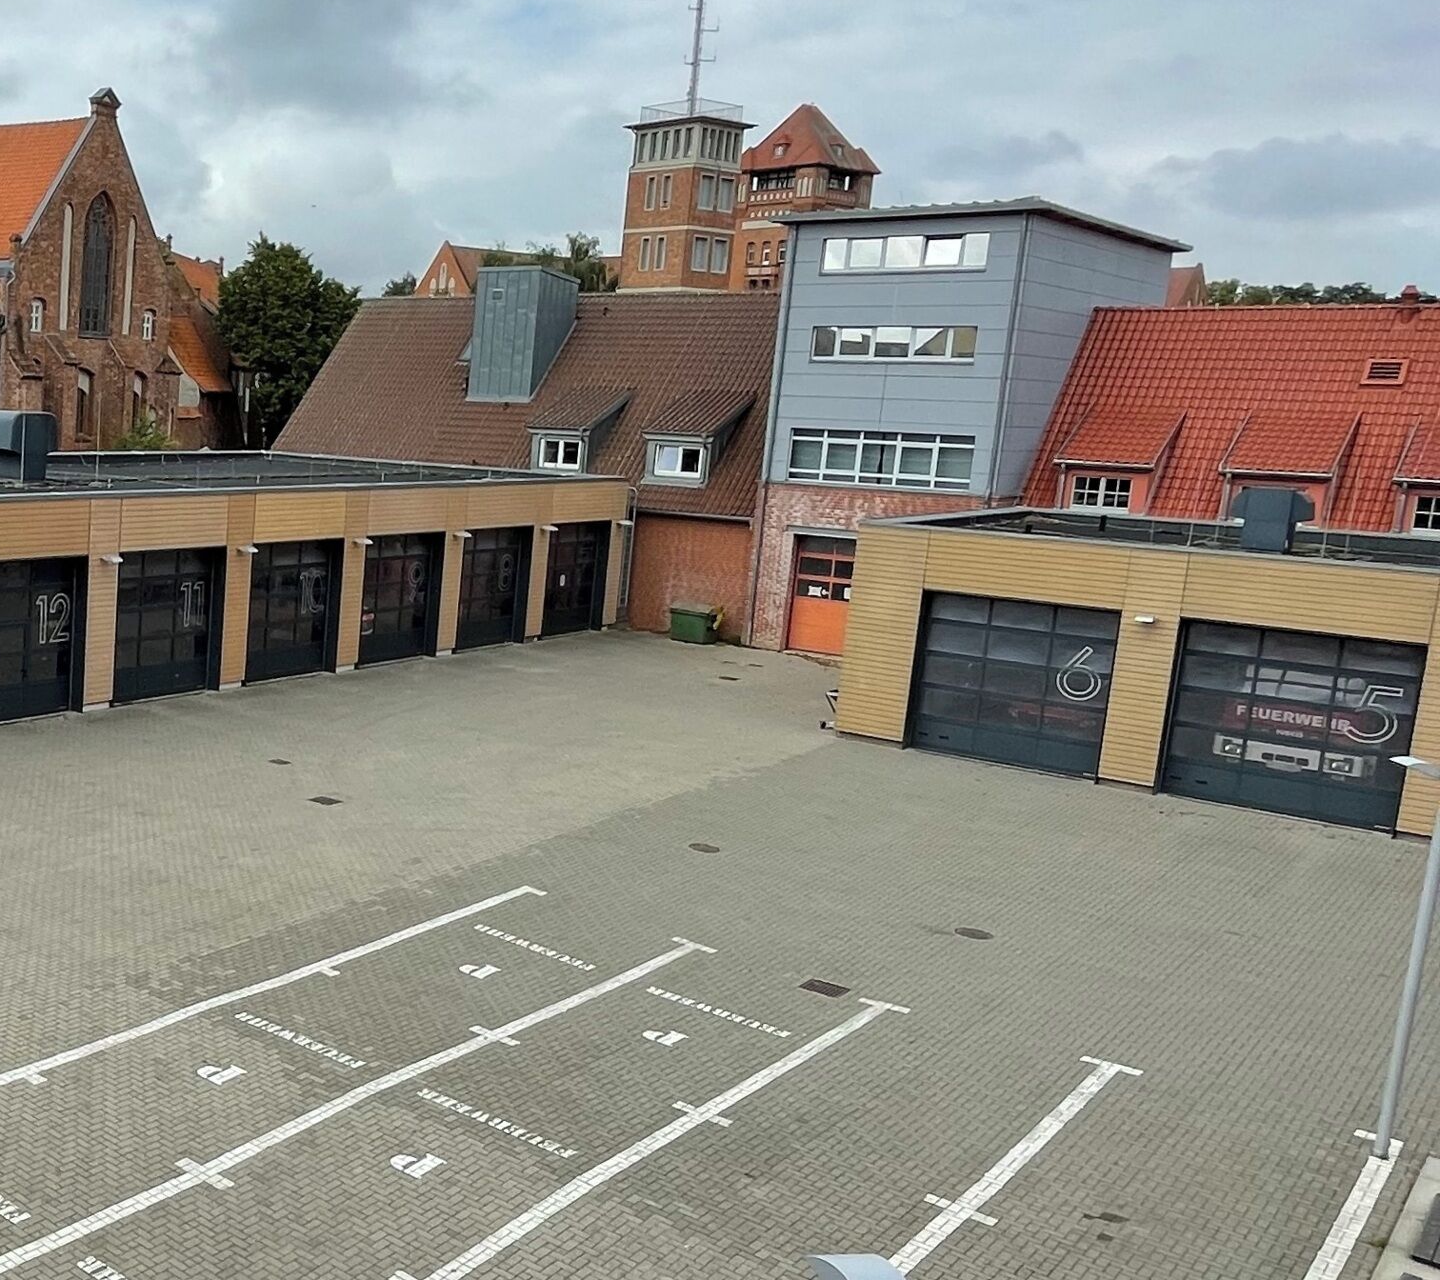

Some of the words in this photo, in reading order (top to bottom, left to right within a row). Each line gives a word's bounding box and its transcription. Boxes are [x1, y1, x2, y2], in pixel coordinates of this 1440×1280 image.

[408, 561, 424, 603] 9
[498, 553, 514, 591] 8
[36, 593, 70, 644] 12
[180, 581, 205, 627] 11
[1055, 645, 1102, 701] 6
[1236, 705, 1351, 732] FEUERWEHR
[1344, 685, 1404, 744] 5
[459, 964, 502, 980] P
[642, 1030, 689, 1047] P
[196, 1063, 248, 1086] P
[389, 1153, 447, 1180] P
